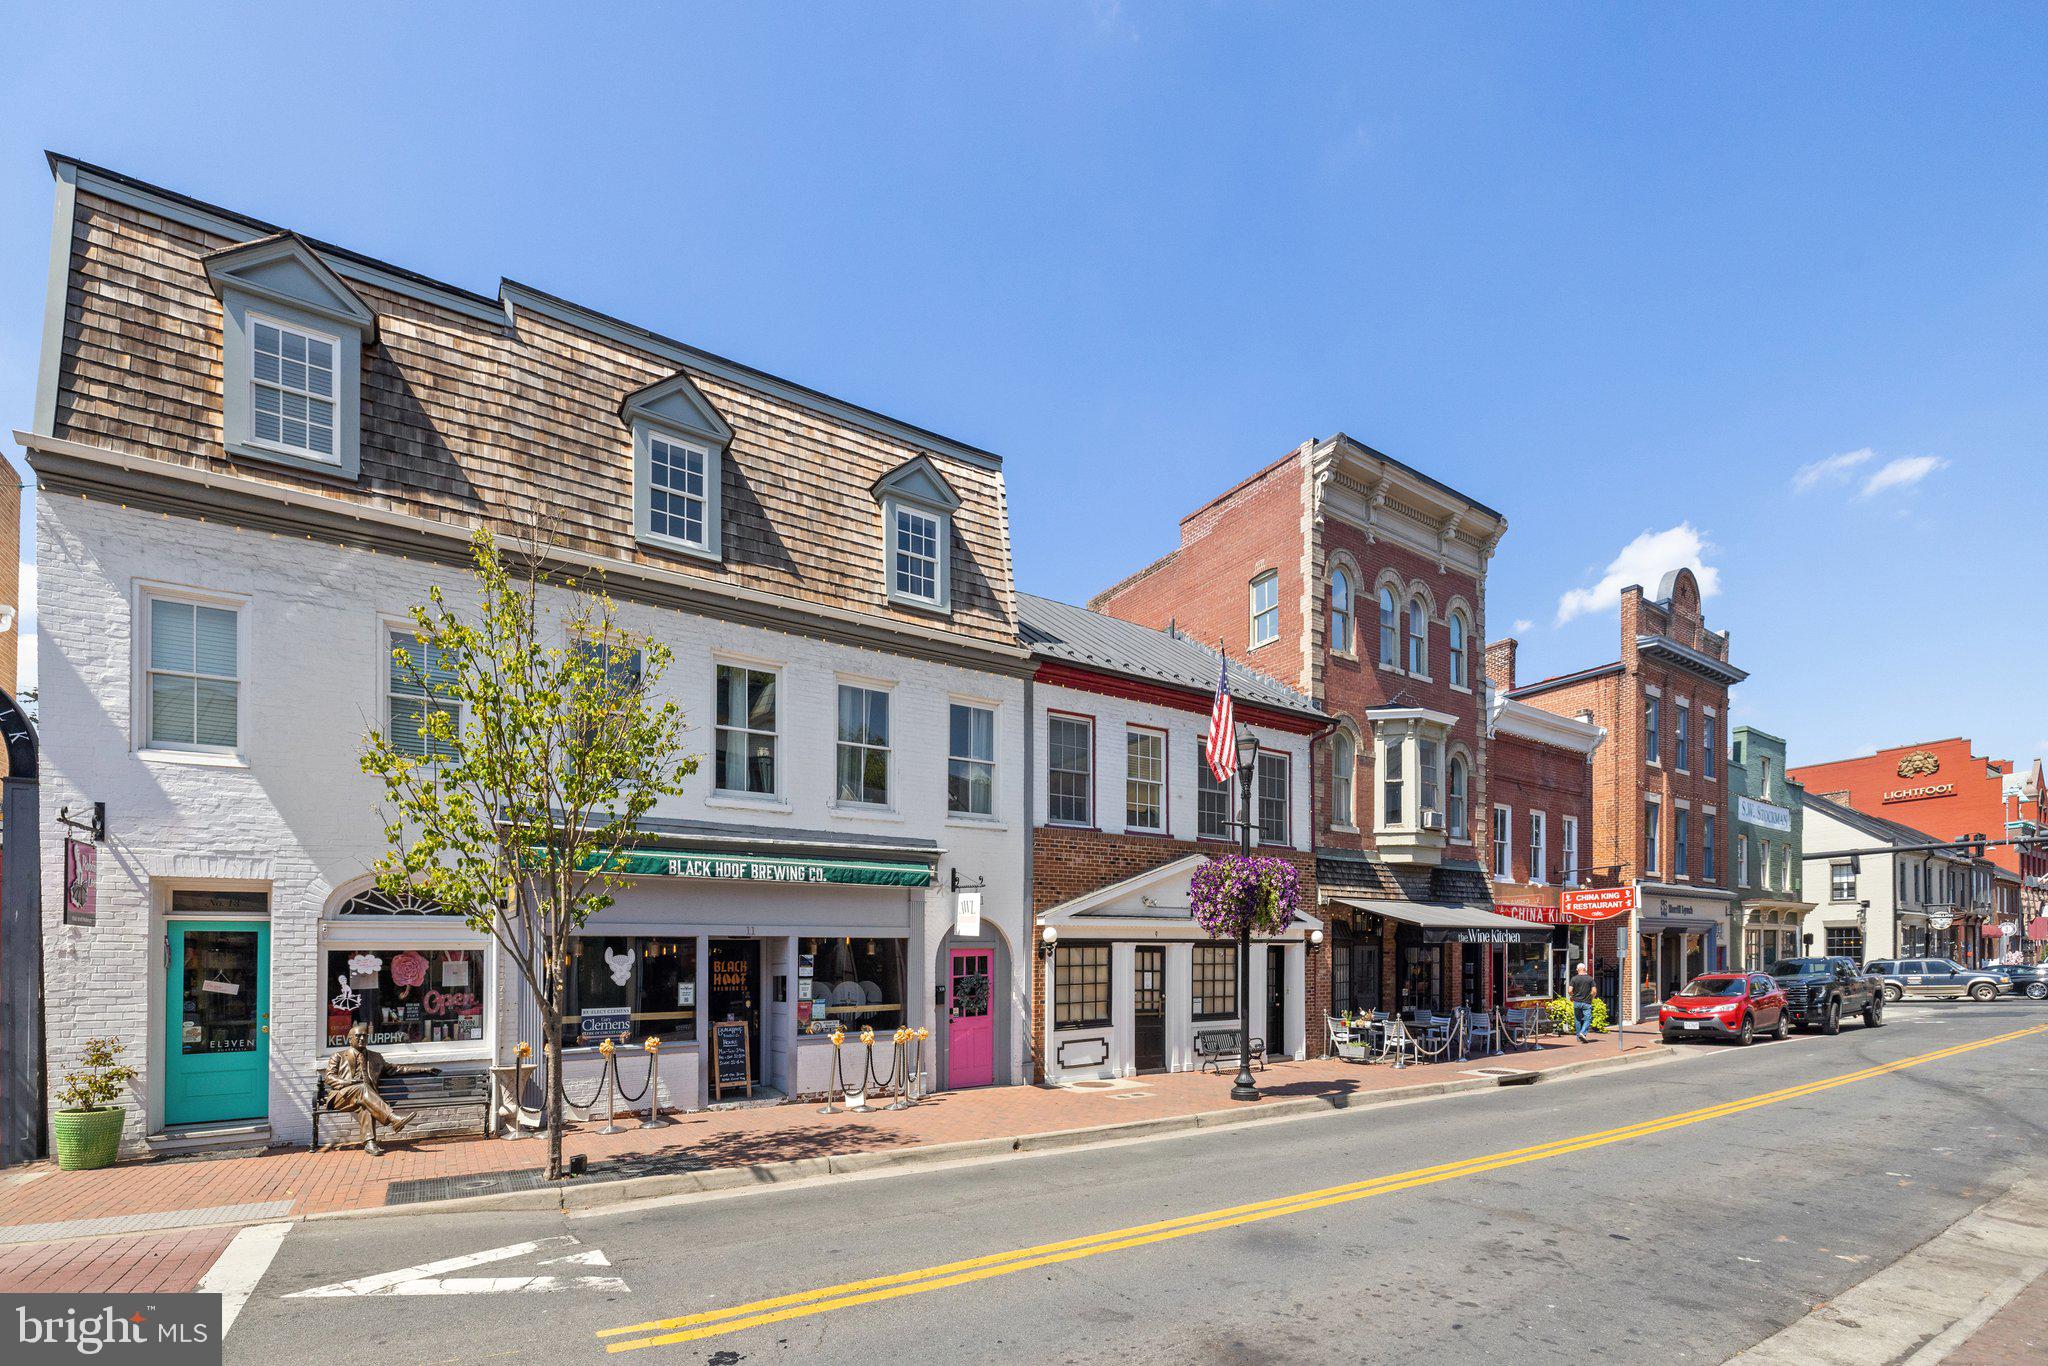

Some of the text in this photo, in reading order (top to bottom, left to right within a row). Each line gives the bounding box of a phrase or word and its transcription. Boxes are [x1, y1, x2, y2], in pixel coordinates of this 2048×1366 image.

[1883, 783, 1954, 801] LIGHTFOOT
[668, 859, 827, 882] BLACK HOOF BREWING CO.
[1573, 901, 1623, 910] RESTAURANT
[1511, 907, 1543, 922] CHINA
[1549, 907, 1572, 923] KING
[1458, 929, 1520, 943] the Wine Kitchen
[713, 960, 747, 976] BLACK
[423, 989, 477, 1016] Open
[582, 1018, 630, 1031] Clemens
